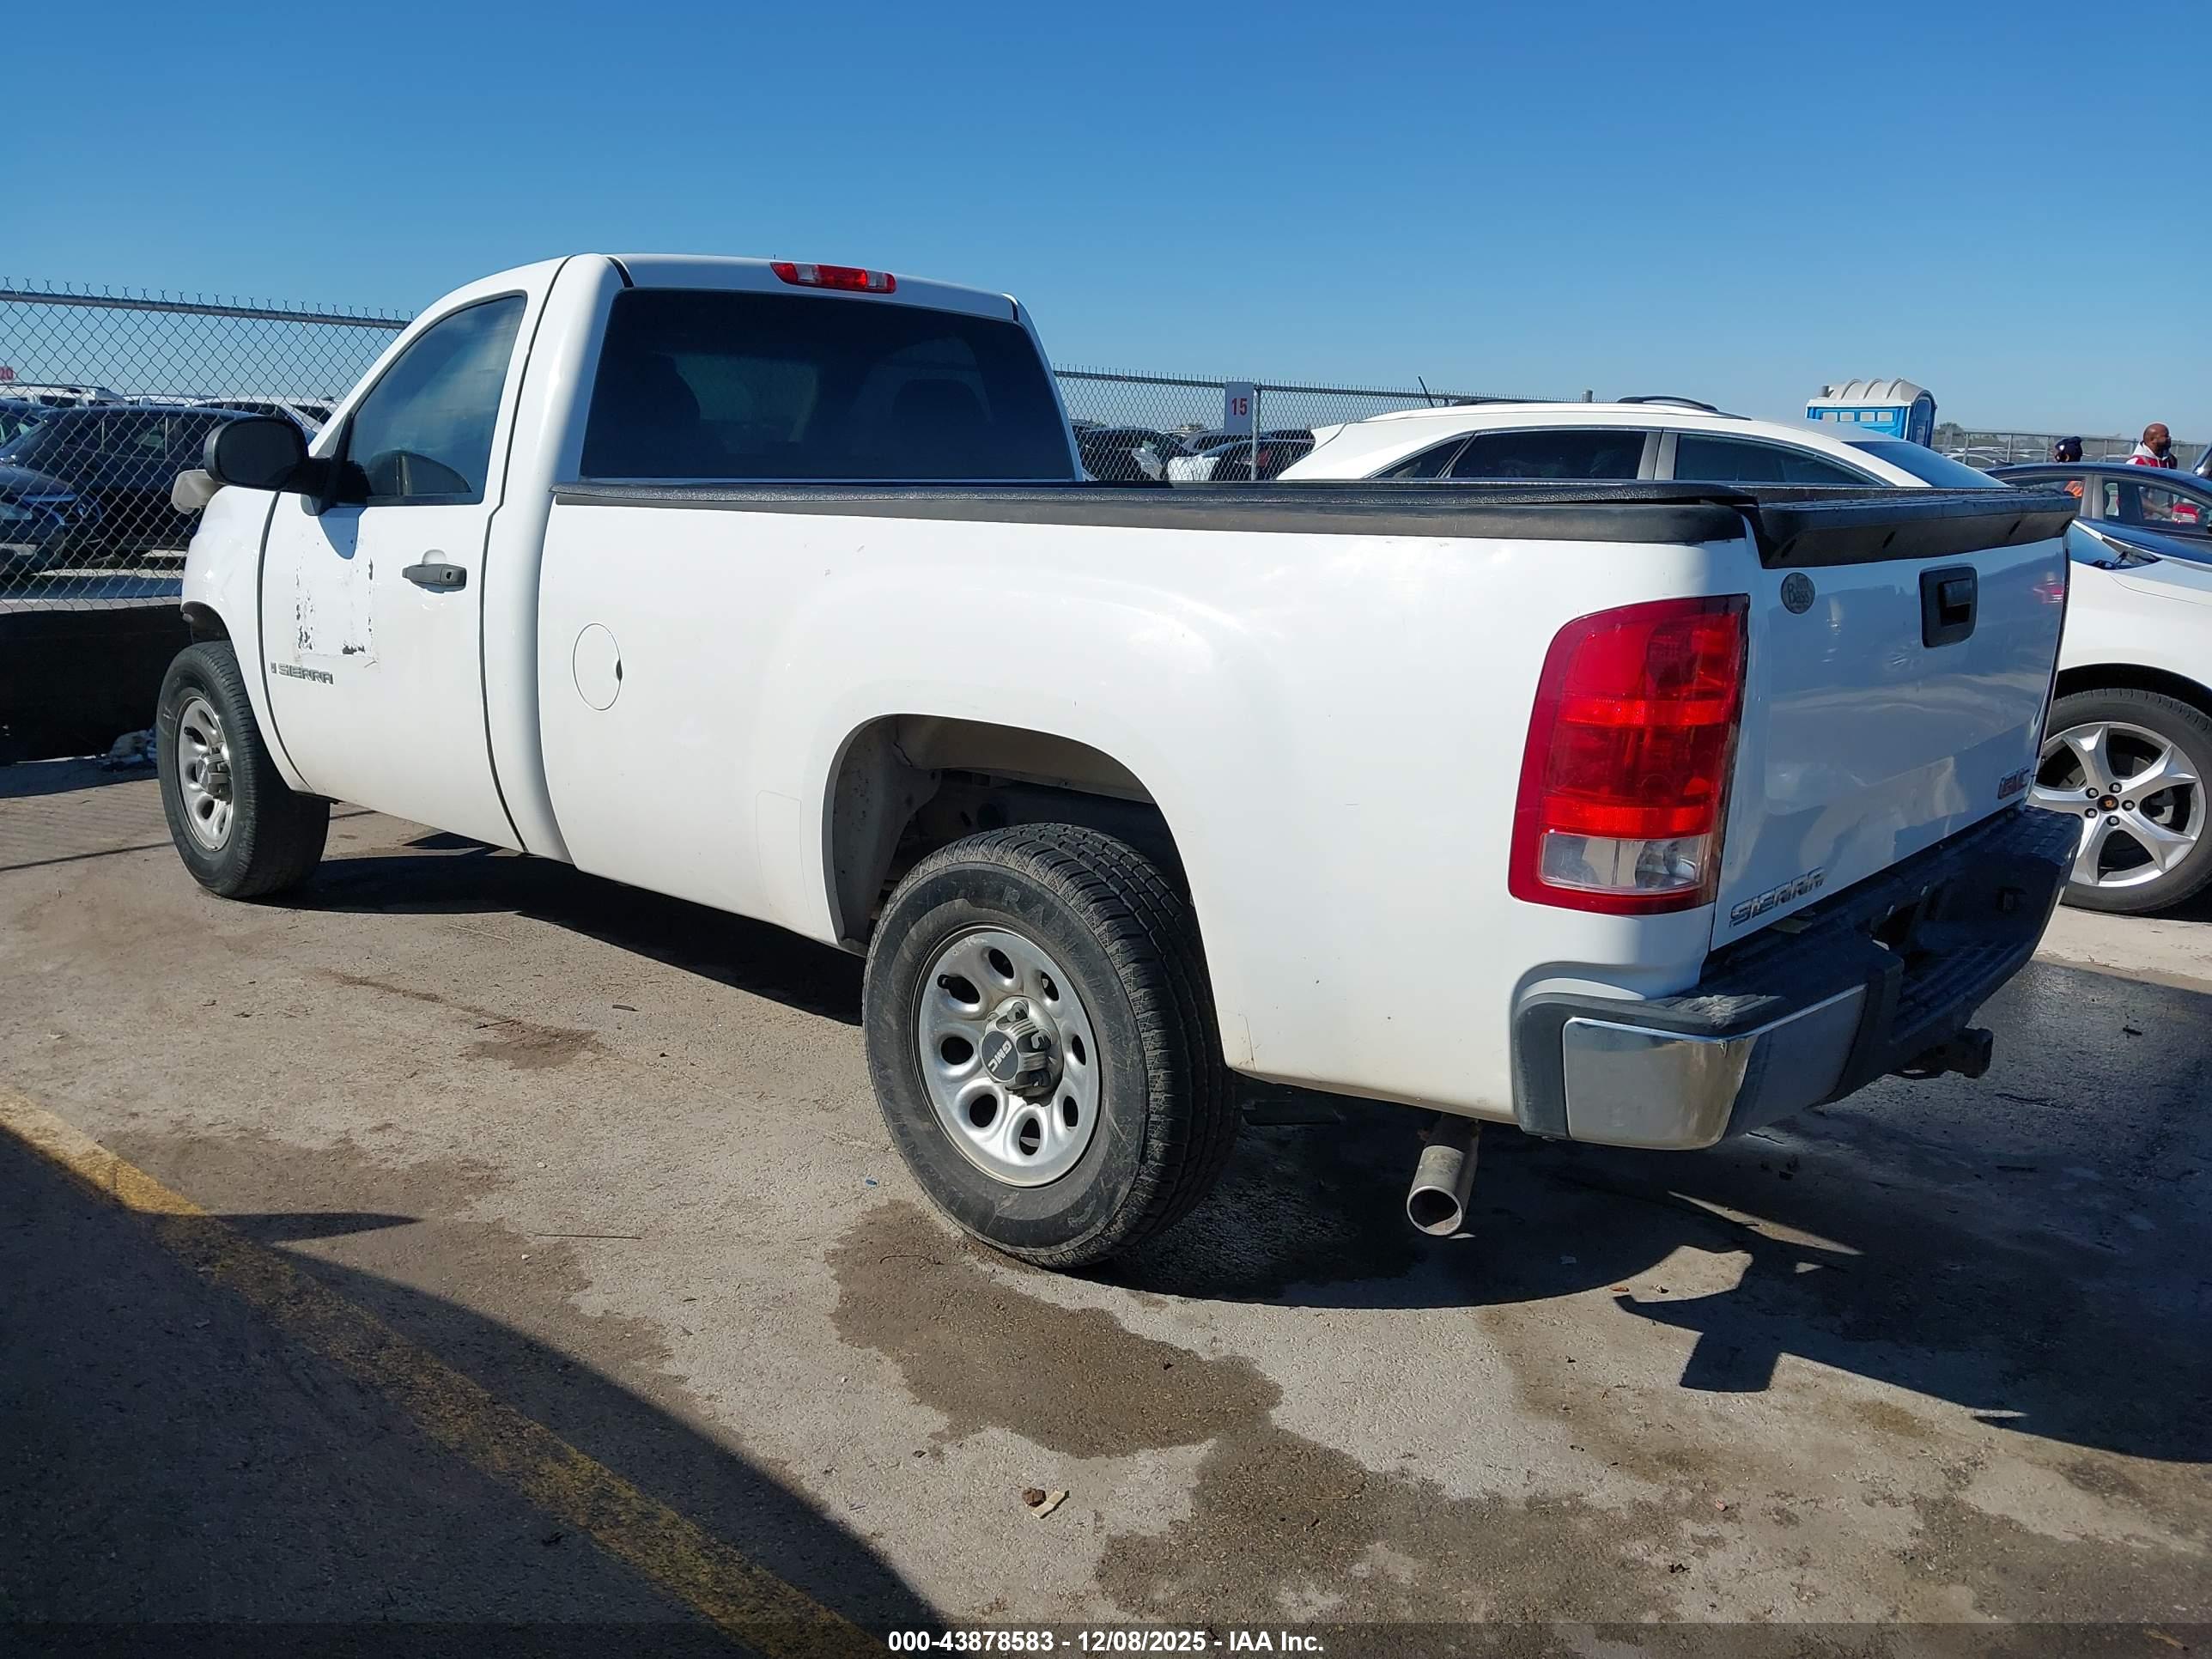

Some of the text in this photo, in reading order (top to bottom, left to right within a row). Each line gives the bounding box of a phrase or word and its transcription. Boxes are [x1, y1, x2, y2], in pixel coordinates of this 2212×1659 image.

[1231, 398, 1248, 416] 15
[278, 662, 334, 684] SIERRA
[1729, 866, 1824, 927] SIERRA
[988, 1040, 1012, 1073] GMC
